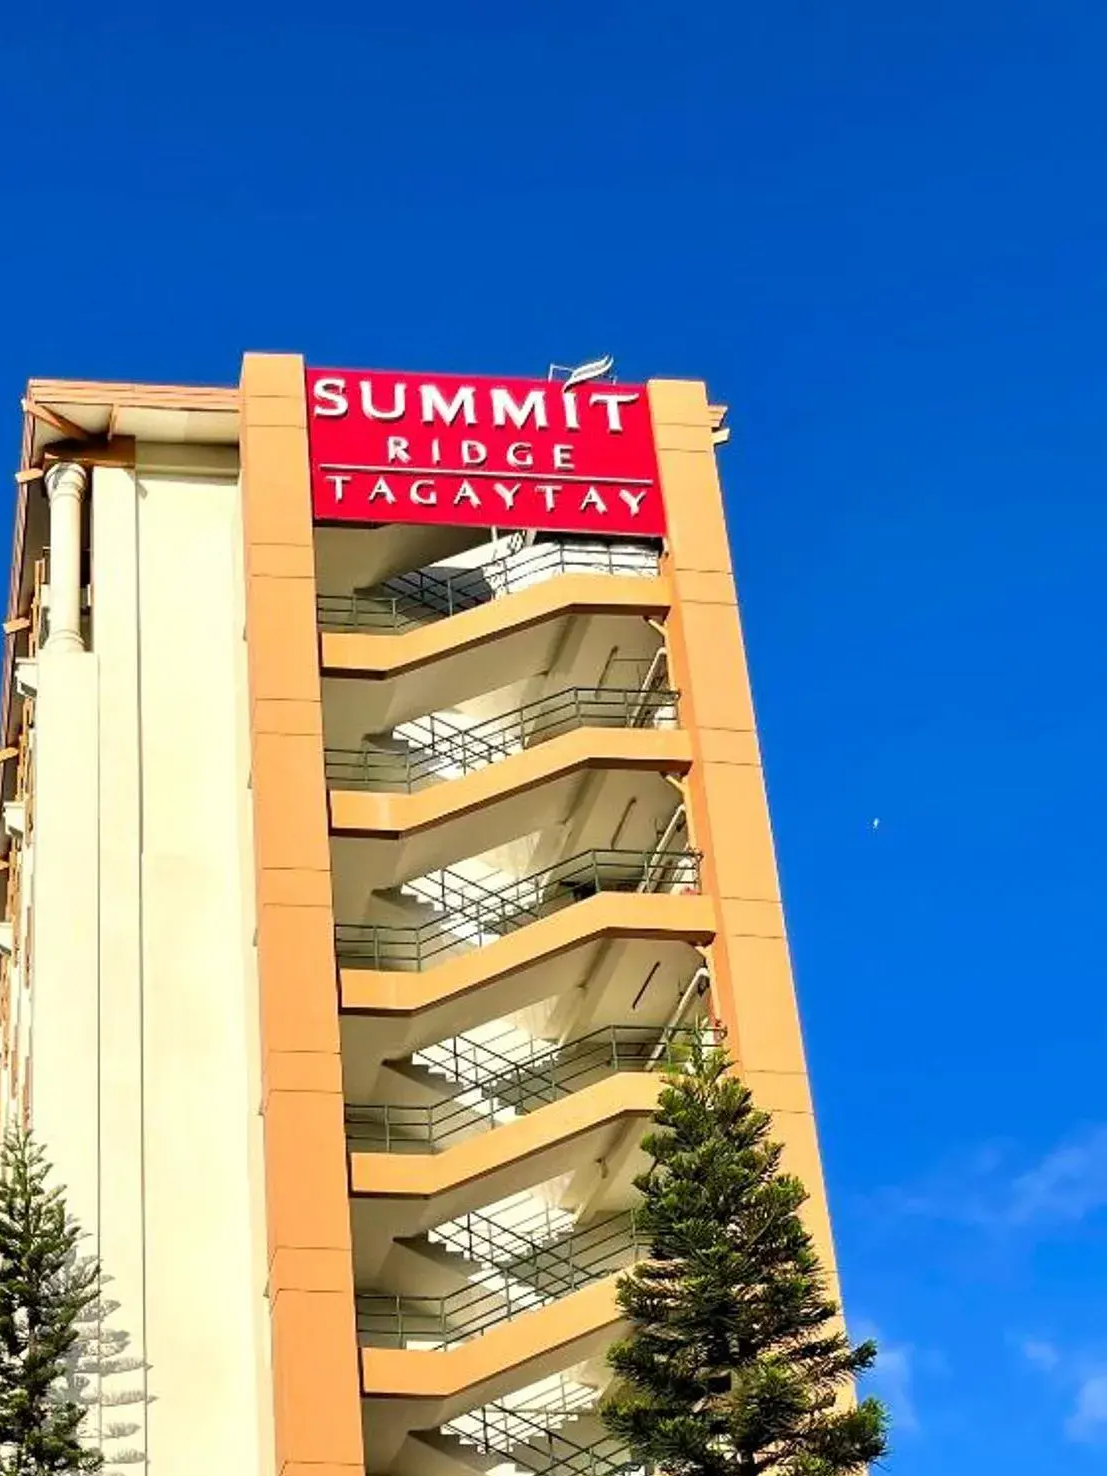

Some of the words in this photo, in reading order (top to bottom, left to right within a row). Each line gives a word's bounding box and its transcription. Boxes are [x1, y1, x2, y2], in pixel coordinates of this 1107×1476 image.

[312, 378, 639, 432] SUMMIT
[386, 436, 576, 470] RIDGE
[326, 475, 647, 517] TAGAYTAY
